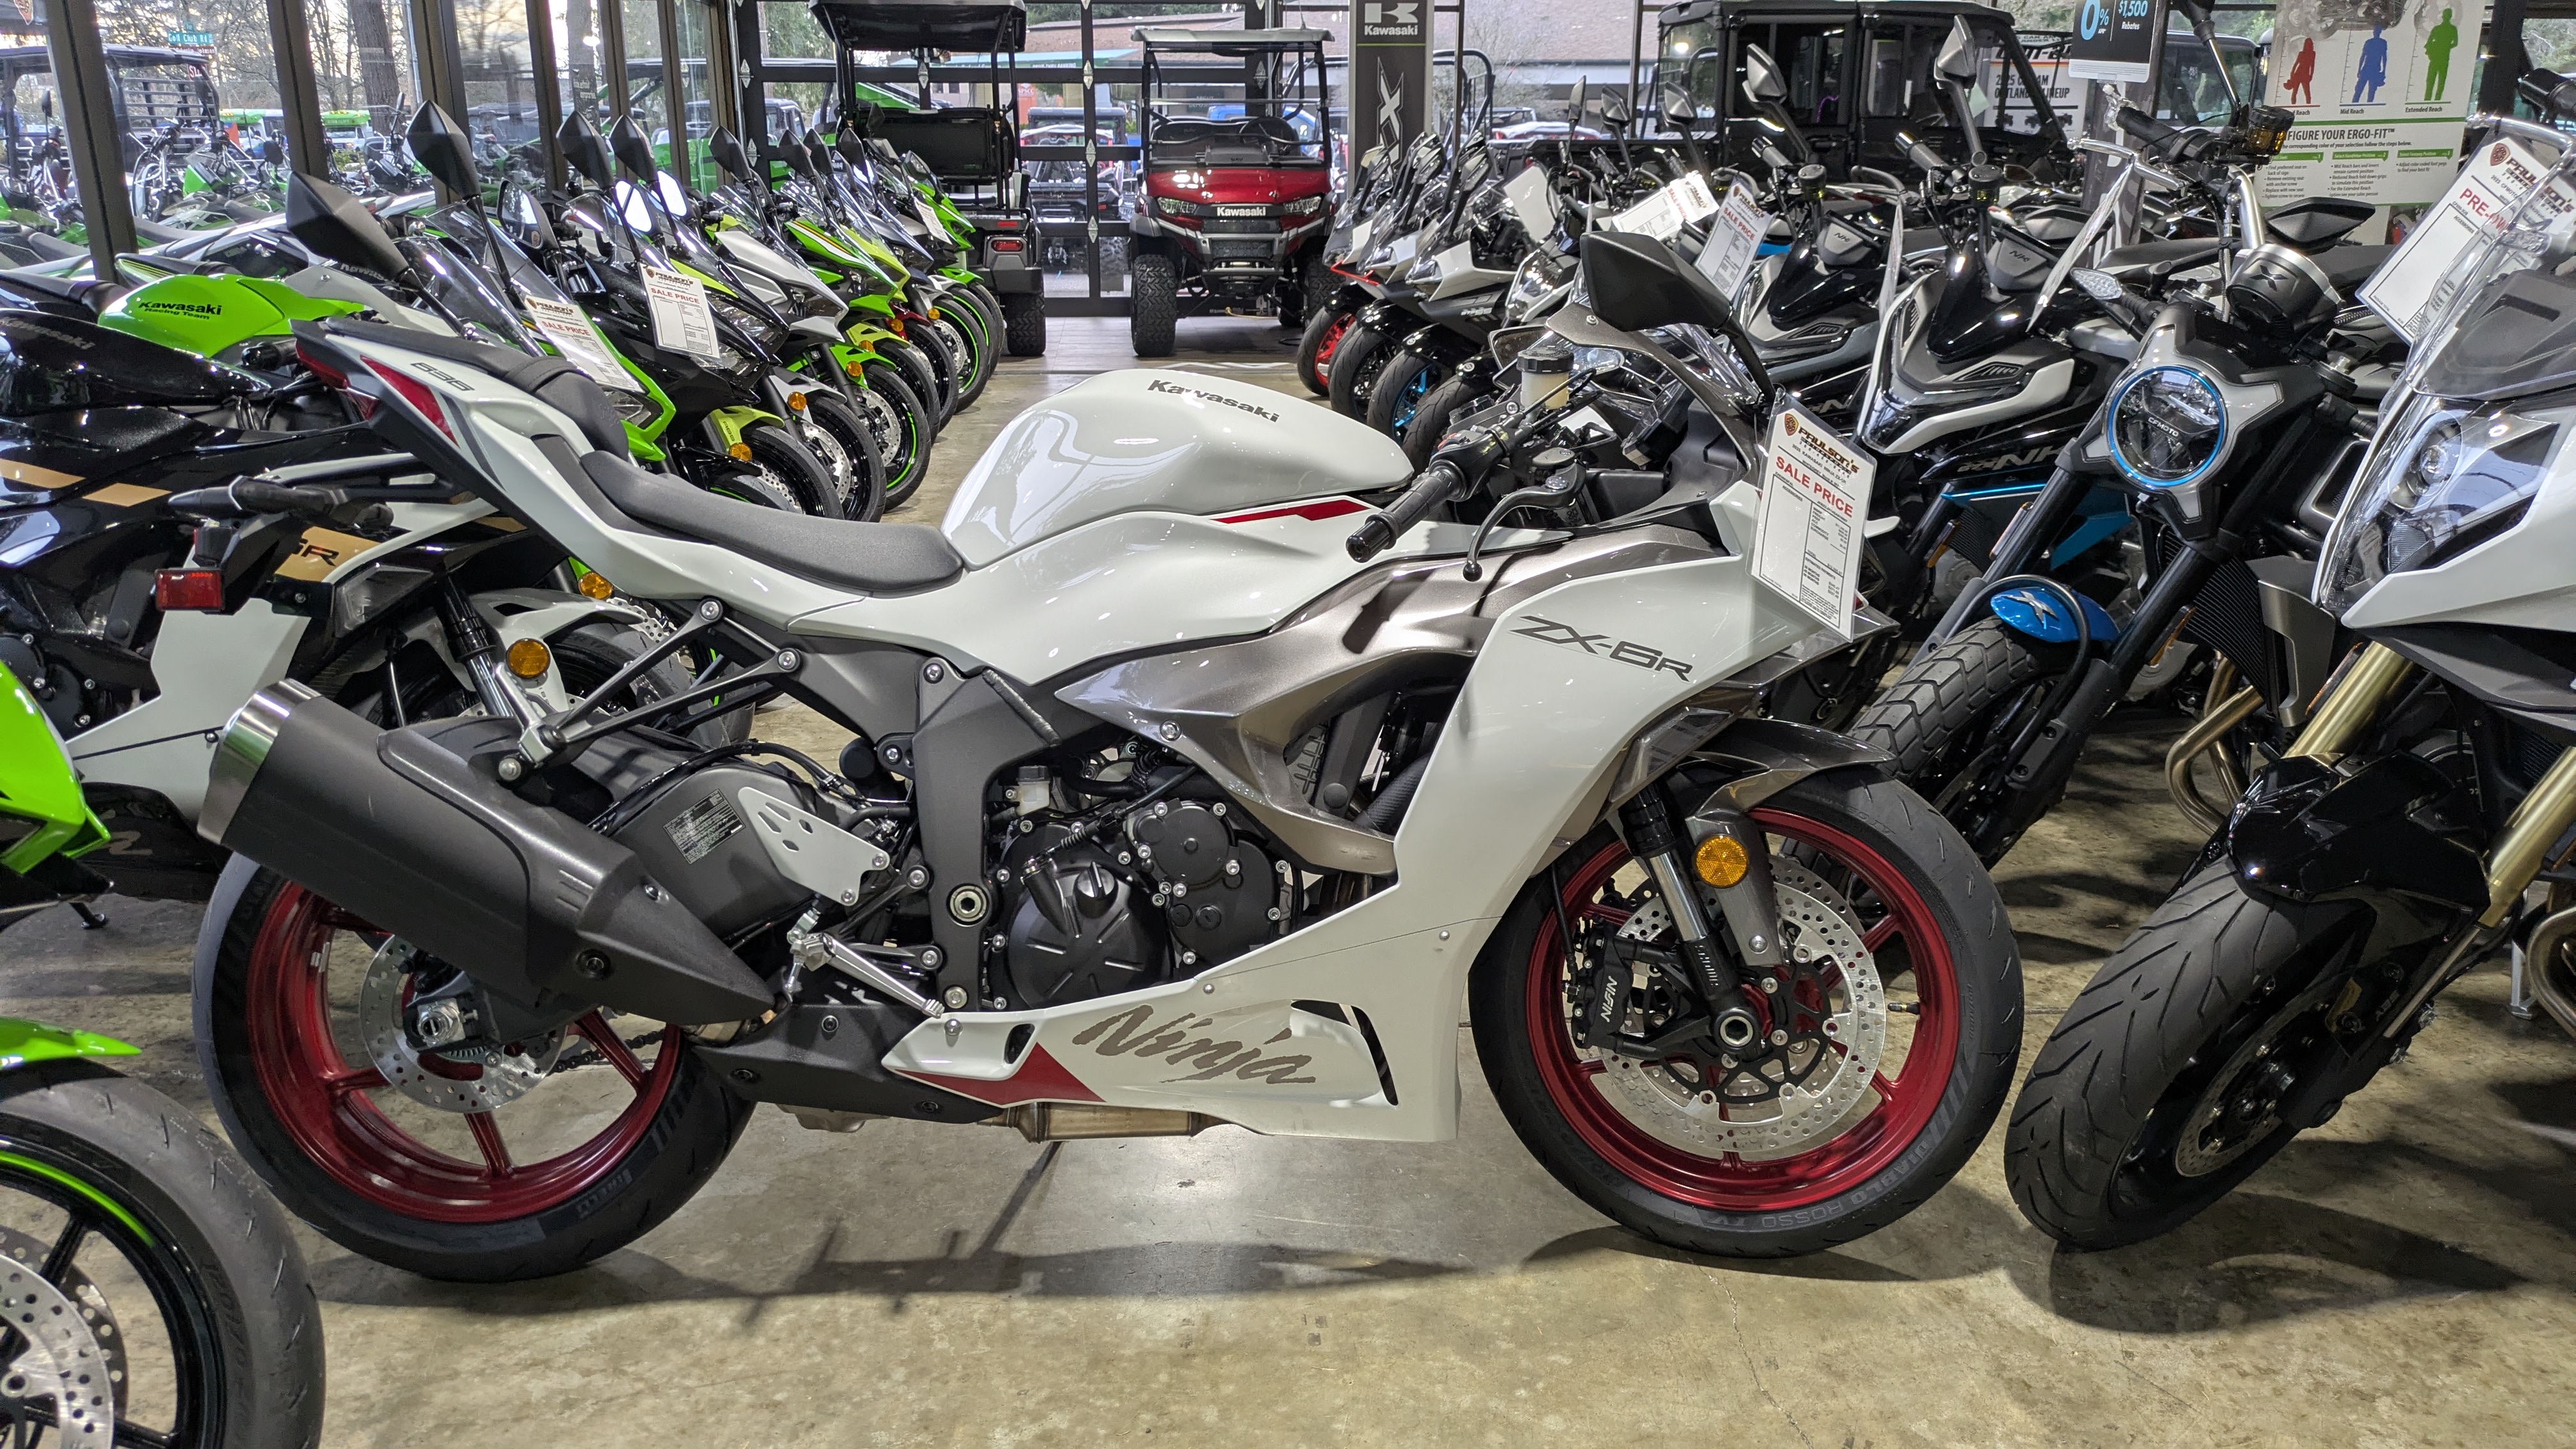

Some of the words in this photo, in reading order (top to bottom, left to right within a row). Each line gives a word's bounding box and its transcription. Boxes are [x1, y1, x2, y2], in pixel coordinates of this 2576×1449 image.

[2119, 0, 2148, 18] $1,500
[1365, 25, 1418, 35] Kawasaki
[1995, 75, 2016, 86] 225
[2287, 130, 2320, 141] FIGURE
[2321, 130, 2345, 140] YOUR
[1217, 207, 1266, 217] Kawasaki
[1724, 208, 1737, 223] SALE
[1737, 221, 1755, 241] PRICE
[651, 288, 673, 298] SALE
[675, 293, 700, 304] PRICE
[138, 300, 222, 315] Kawasaki
[144, 307, 180, 316] Racing
[182, 311, 210, 320] Team
[542, 321, 564, 331] SALE
[565, 326, 591, 336] PRICE
[410, 362, 475, 391] 636
[1147, 379, 1280, 424] Kawasaki
[723, 421, 735, 441] ABS
[2148, 417, 2179, 437] CFMOTO
[1792, 444, 1800, 452] 2025
[1802, 452, 1822, 468] KAWASAKI
[1824, 466, 1834, 476] NINJA
[1776, 456, 1811, 489] SALE
[1813, 482, 1853, 518] PRICE
[1510, 615, 1693, 682] ZX-6R
[1601, 975, 1617, 1022] NISSIN
[1072, 1004, 1315, 1084] Ninja
[1852, 1140, 1927, 1206] DIABLO
[1762, 1201, 1844, 1228] ROSSO
